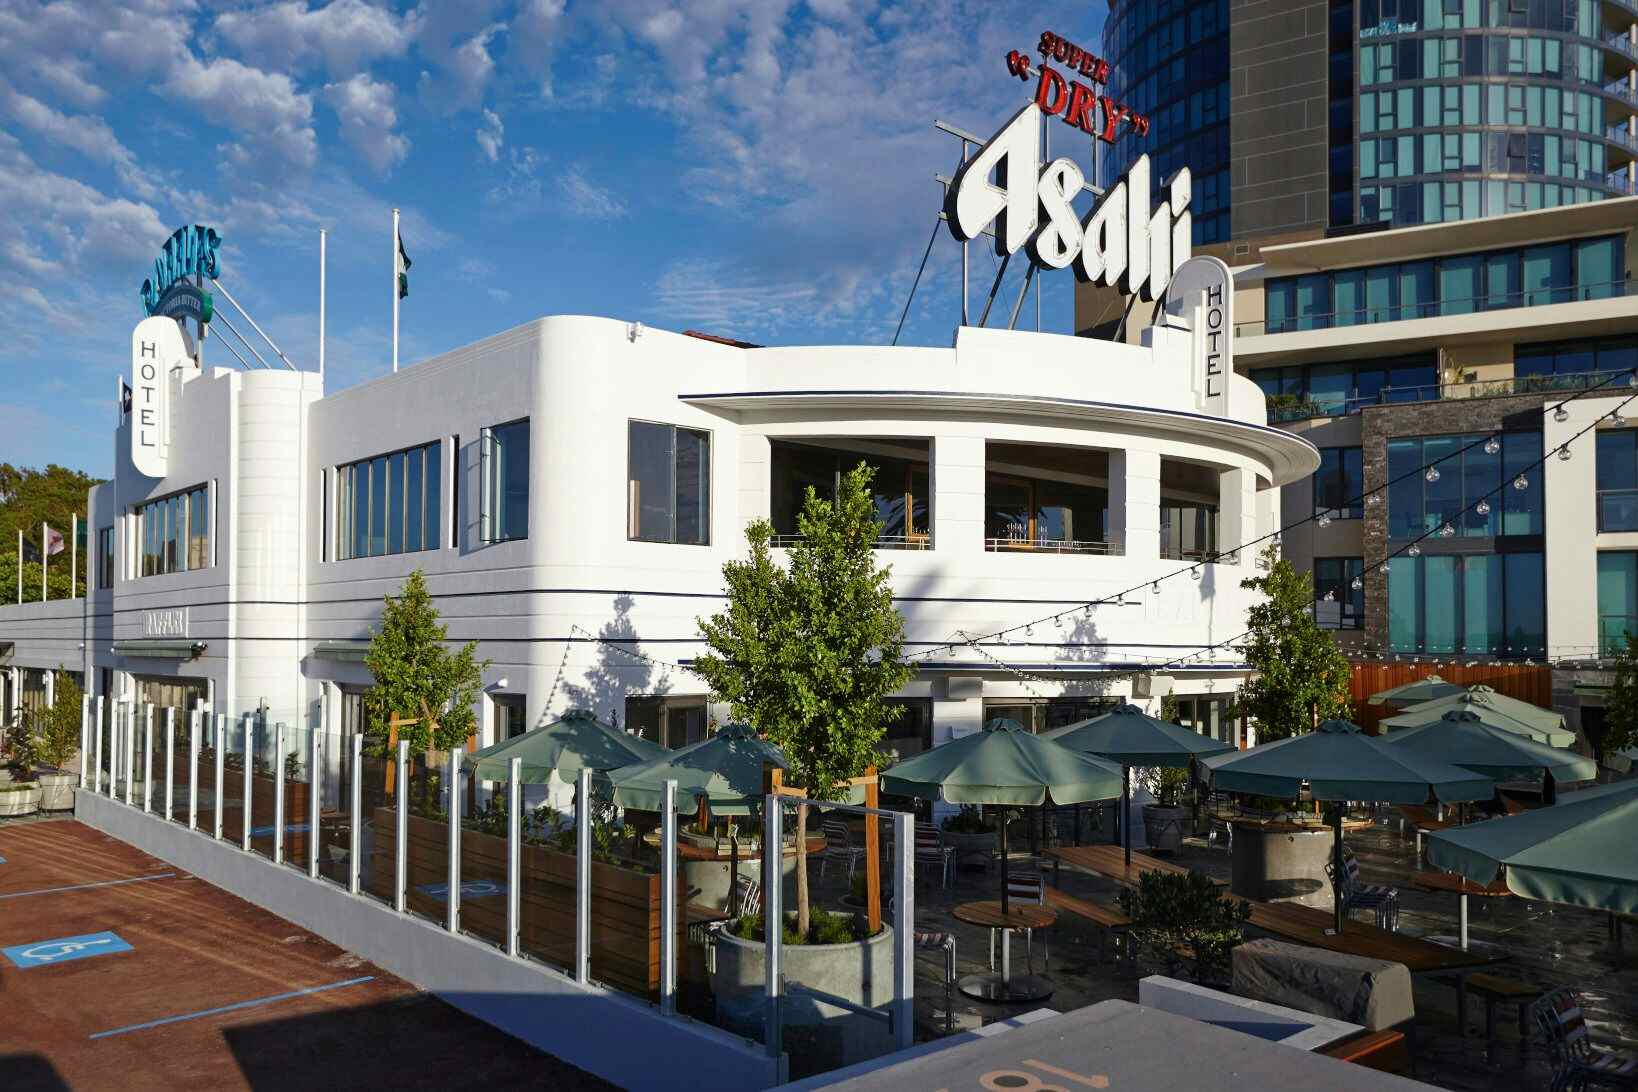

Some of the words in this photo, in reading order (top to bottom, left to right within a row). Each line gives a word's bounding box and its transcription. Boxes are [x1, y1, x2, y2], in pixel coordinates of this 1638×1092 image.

[1037, 31, 1110, 86] SUPER
[946, 102, 1192, 302] Asahi
[140, 340, 156, 447] HOTEL
[1207, 284, 1223, 398] HOTEL
